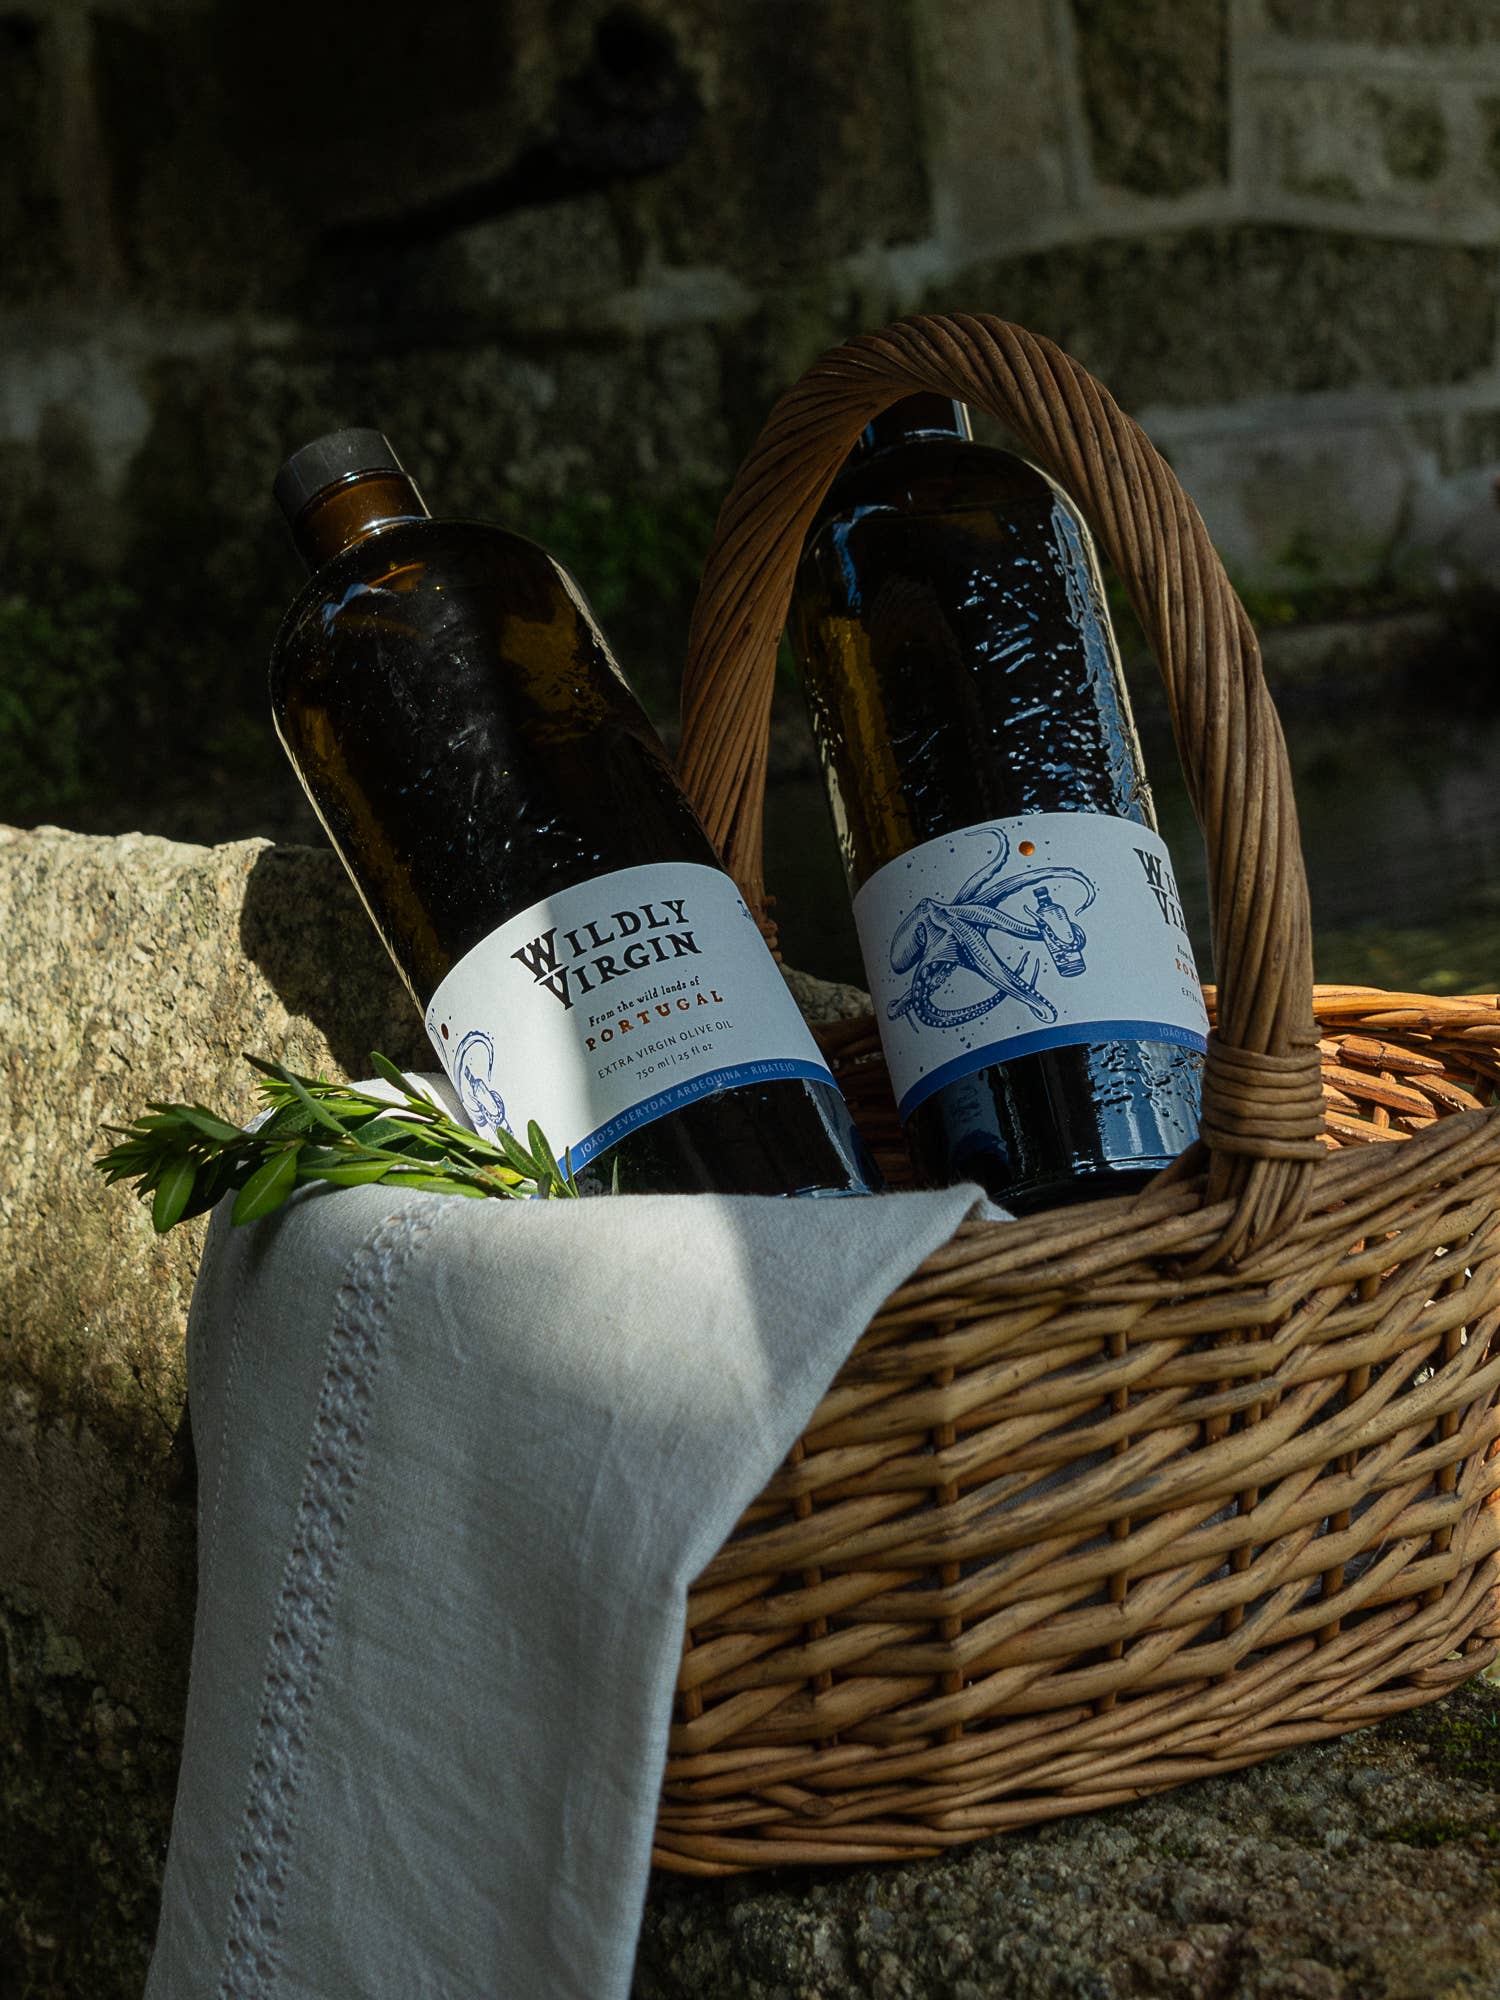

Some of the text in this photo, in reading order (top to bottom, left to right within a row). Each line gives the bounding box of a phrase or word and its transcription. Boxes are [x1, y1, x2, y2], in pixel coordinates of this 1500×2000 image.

[510, 900, 690, 983] WILDLY
[539, 931, 702, 1010] VIRGIN
[585, 990, 724, 1052] PORTUGAL
[588, 975, 700, 1027] From the wild lands of
[598, 1020, 734, 1079] EXTRA VIRGIN OLIVE OIL
[635, 1066, 655, 1080] 750
[657, 1057, 670, 1069] ml
[678, 1052, 690, 1061] 25
[691, 1046, 701, 1056] fl
[702, 1043, 714, 1052] oz
[580, 1126, 615, 1158] JOÃO'S
[615, 1095, 673, 1131] EVERYDAY
[676, 1070, 742, 1099] ARBEQUINA
[751, 1063, 796, 1076] RIBATEJO
